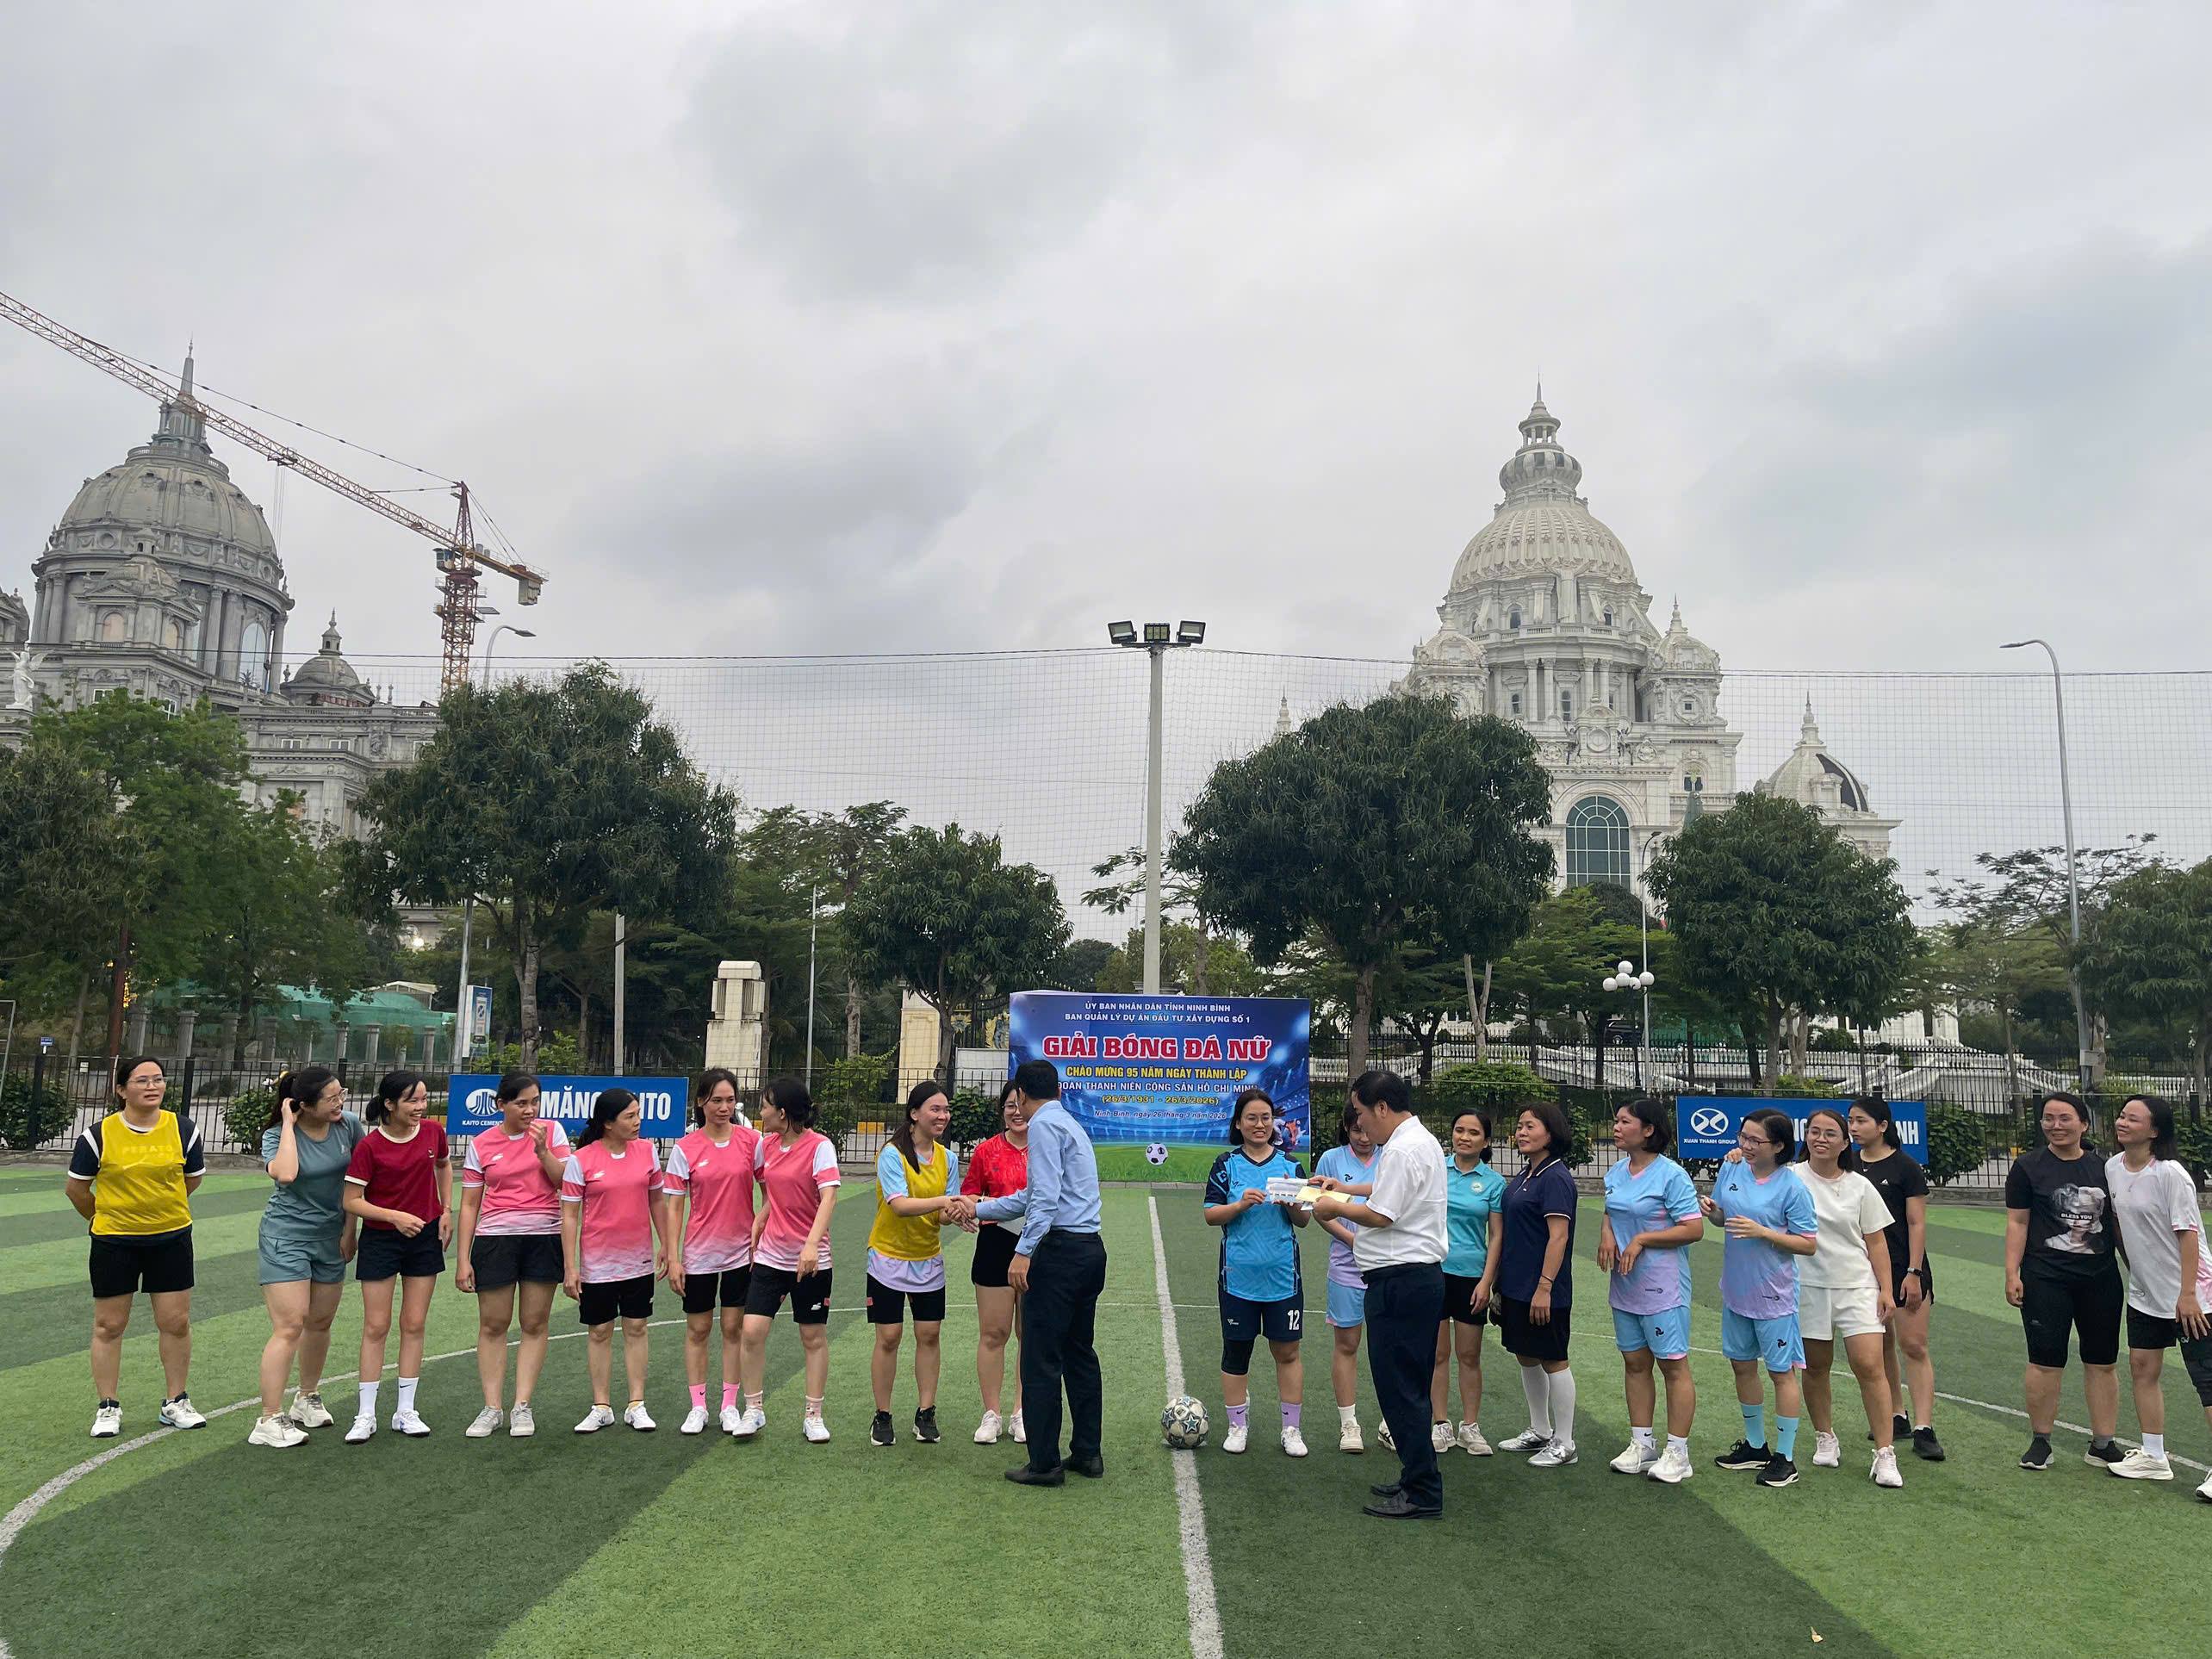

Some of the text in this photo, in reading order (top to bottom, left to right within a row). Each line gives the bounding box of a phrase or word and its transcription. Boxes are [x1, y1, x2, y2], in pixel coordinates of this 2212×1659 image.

[1118, 1002, 1143, 1010] NHÂN
[1145, 1003, 1162, 1011] DÂN
[1165, 1002, 1184, 1011] TỈNH
[1209, 1003, 1231, 1012] BÌNH
[1084, 1011, 1109, 1021] QUẢN
[1122, 1014, 1136, 1022] DỰ
[1185, 1014, 1203, 1022] XÂY
[1205, 1016, 1230, 1024] DỰNG
[1232, 1014, 1245, 1023] SỐ
[1042, 1032, 1271, 1061] GIẢI BÓNG ĐÁ NỮ
[1066, 1065, 1247, 1081] CHÀO MỪNG 95 NĂM NGÀY THÀNH LẬP
[1175, 1081, 1194, 1091] SẢN
[1165, 1097, 1219, 1106] 26/3/2026)
[1288, 1310, 1300, 1330] 12
